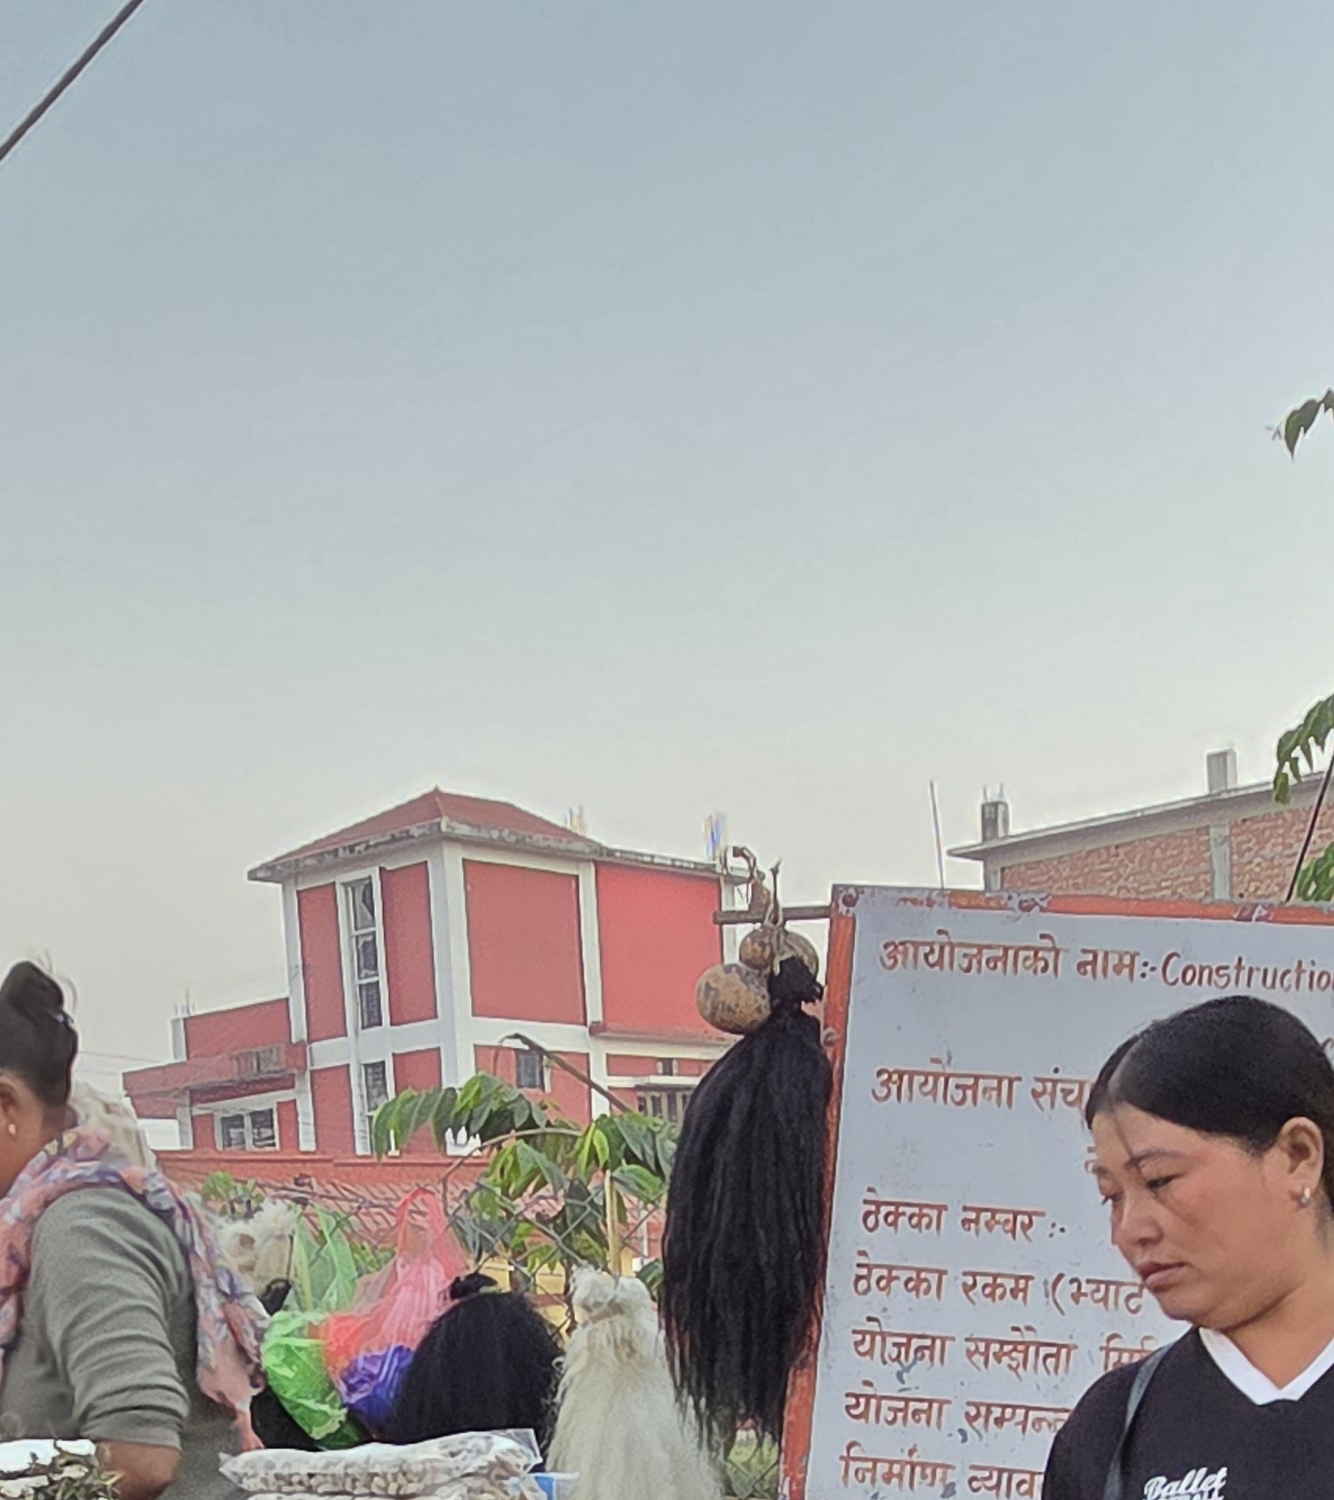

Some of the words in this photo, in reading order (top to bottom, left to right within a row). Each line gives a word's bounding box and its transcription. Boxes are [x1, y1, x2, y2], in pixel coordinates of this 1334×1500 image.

[879, 929, 1062, 979] आयोजनाको
[871, 1057, 1022, 1109] आयोजना
[962, 1270, 1035, 1307] रकम
[851, 1316, 956, 1367] योजना
[844, 1379, 952, 1431] योजना
[839, 1440, 956, 1493] निर्माण
